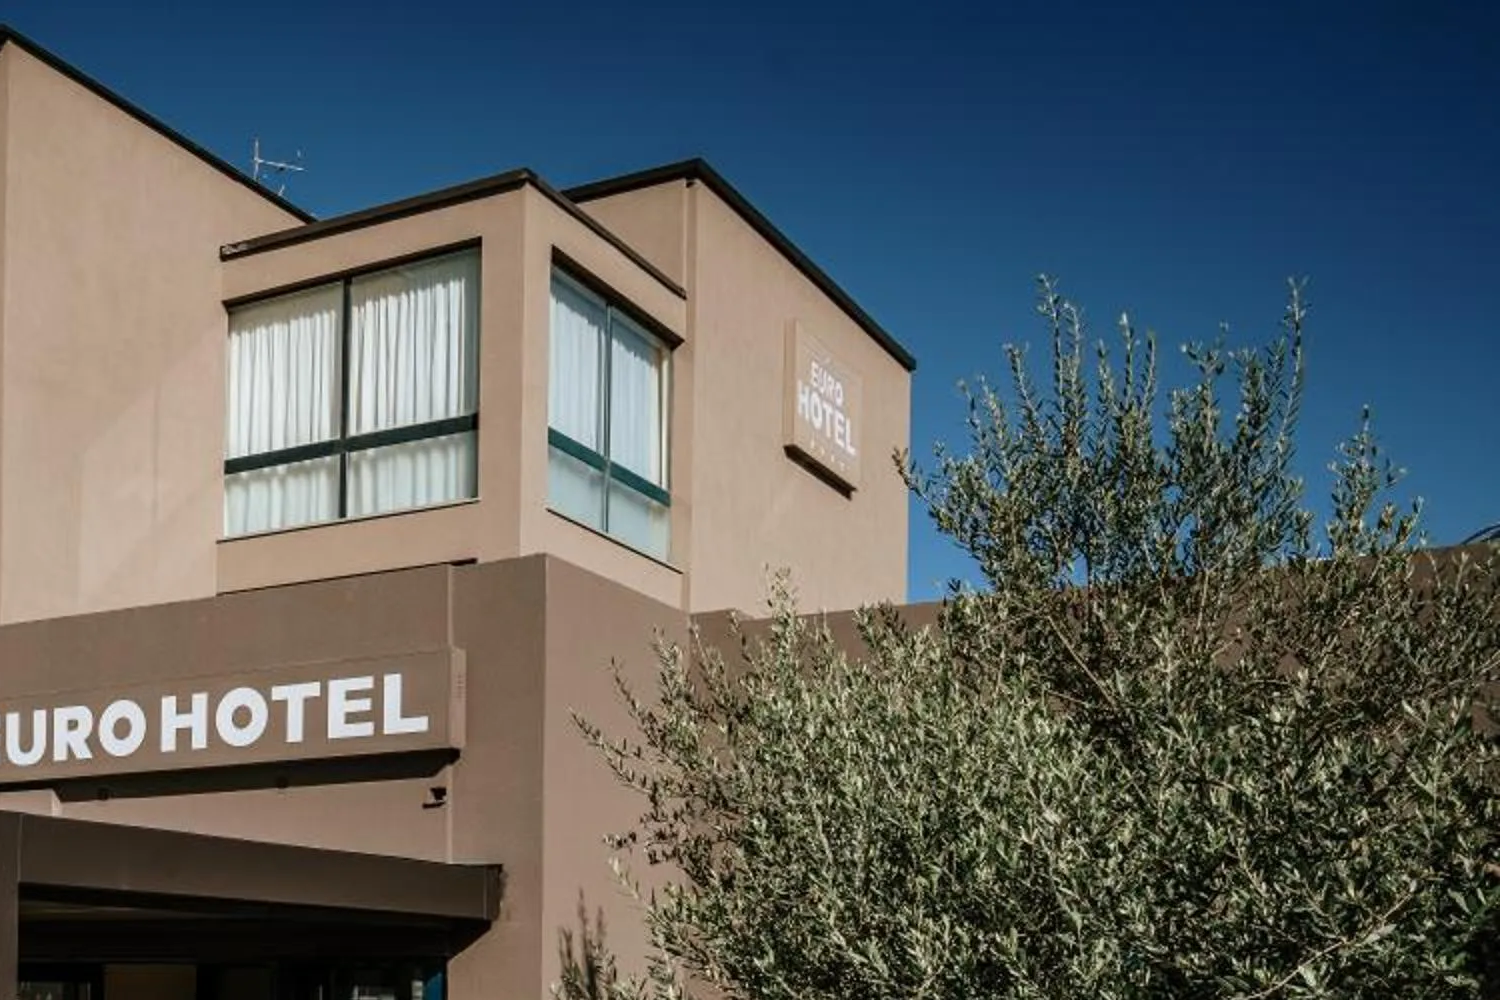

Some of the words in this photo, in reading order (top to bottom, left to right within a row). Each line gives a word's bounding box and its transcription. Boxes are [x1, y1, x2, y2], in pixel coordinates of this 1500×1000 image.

[797, 379, 856, 455] HOTEL
[811, 361, 844, 406] EURO
[160, 673, 429, 753] HOTEL
